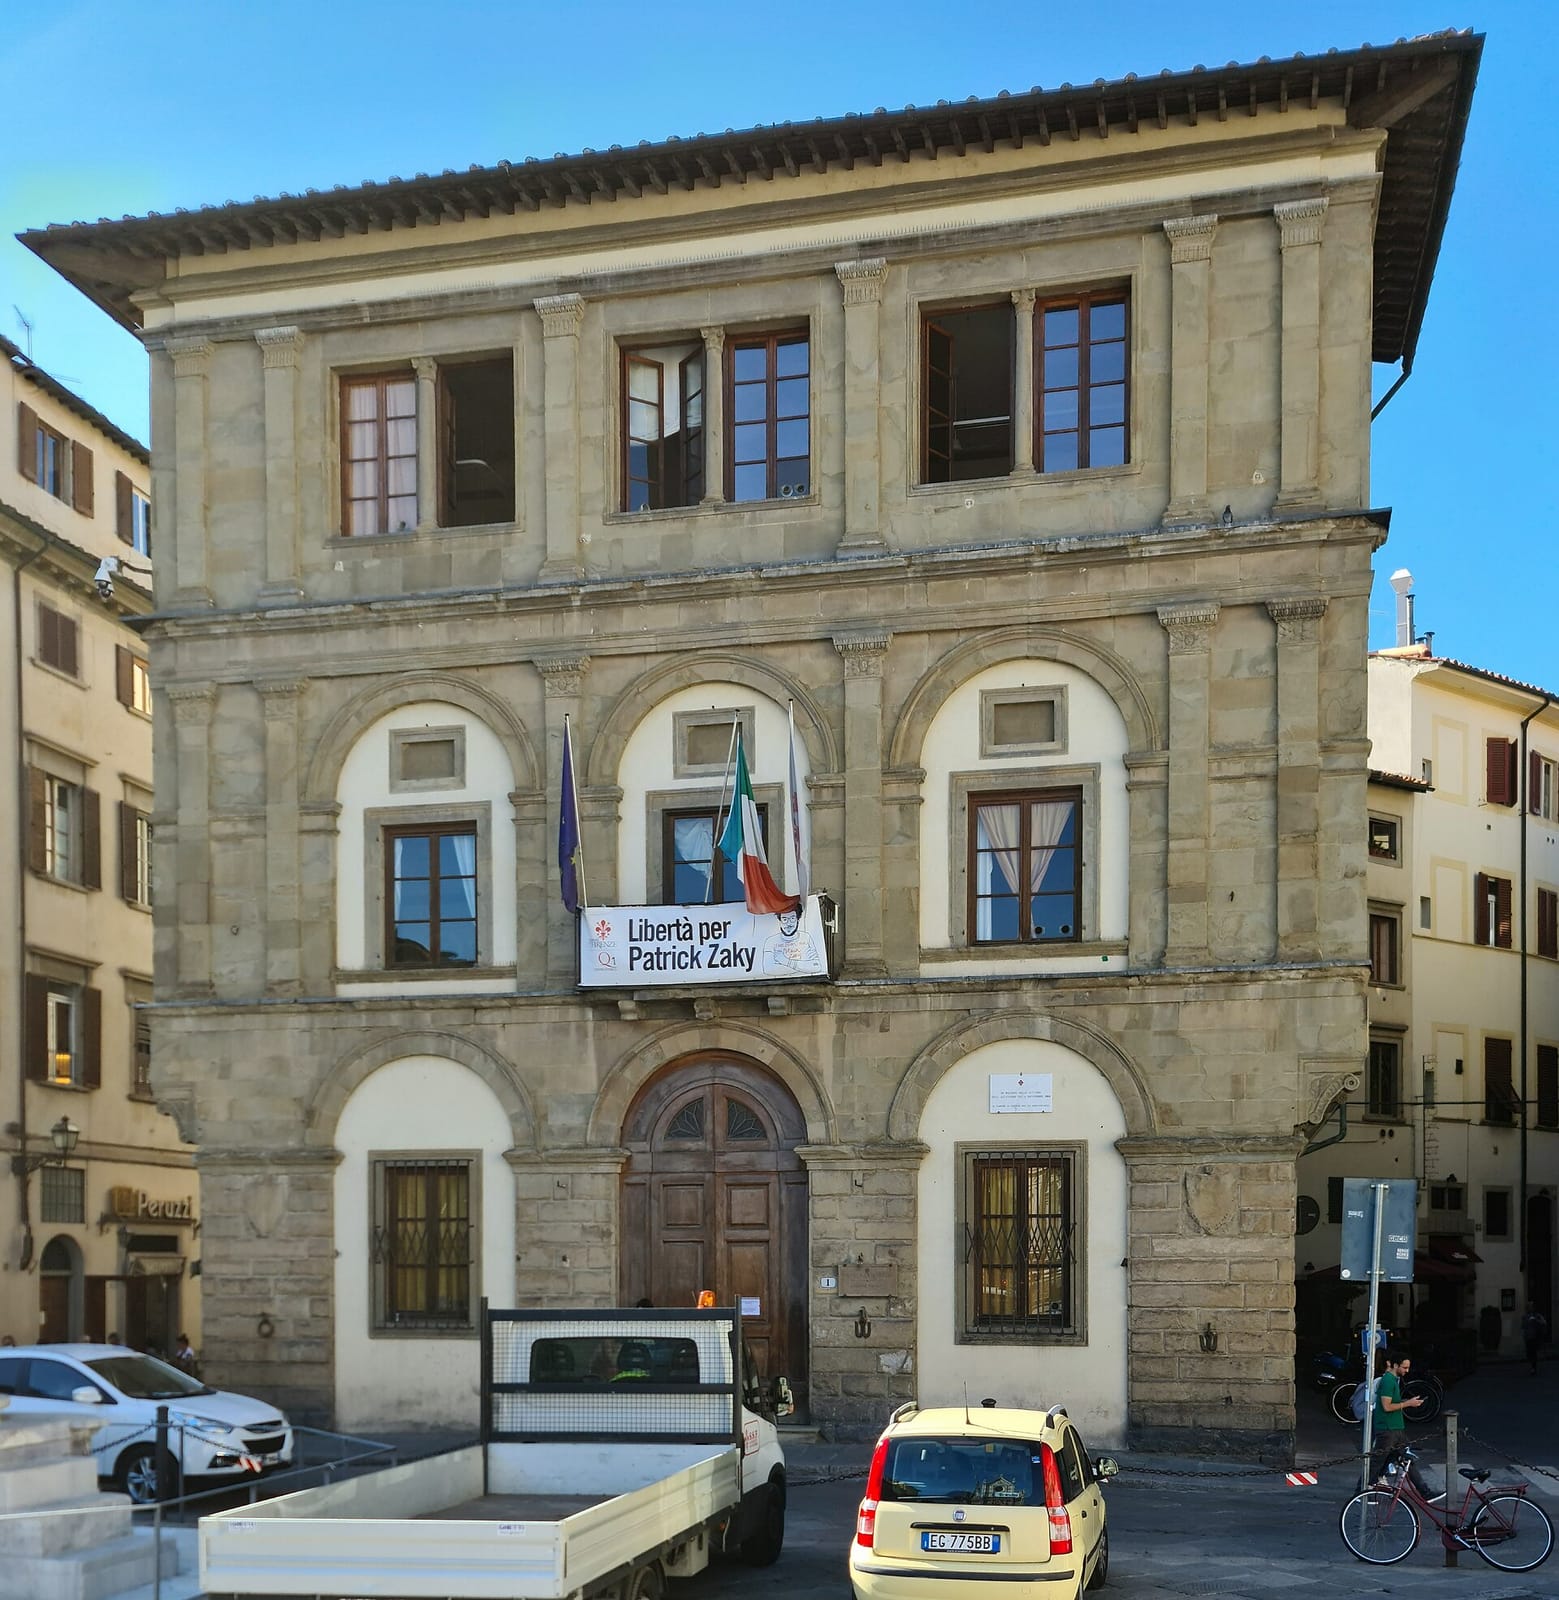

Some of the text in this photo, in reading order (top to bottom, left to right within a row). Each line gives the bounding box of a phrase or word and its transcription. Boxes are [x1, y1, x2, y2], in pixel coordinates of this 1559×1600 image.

[628, 916, 731, 945] Libertà per
[629, 942, 756, 972] Patrick Zaky
[138, 1189, 192, 1218] Peruzzi
[930, 1534, 991, 1549] EG 775BB
